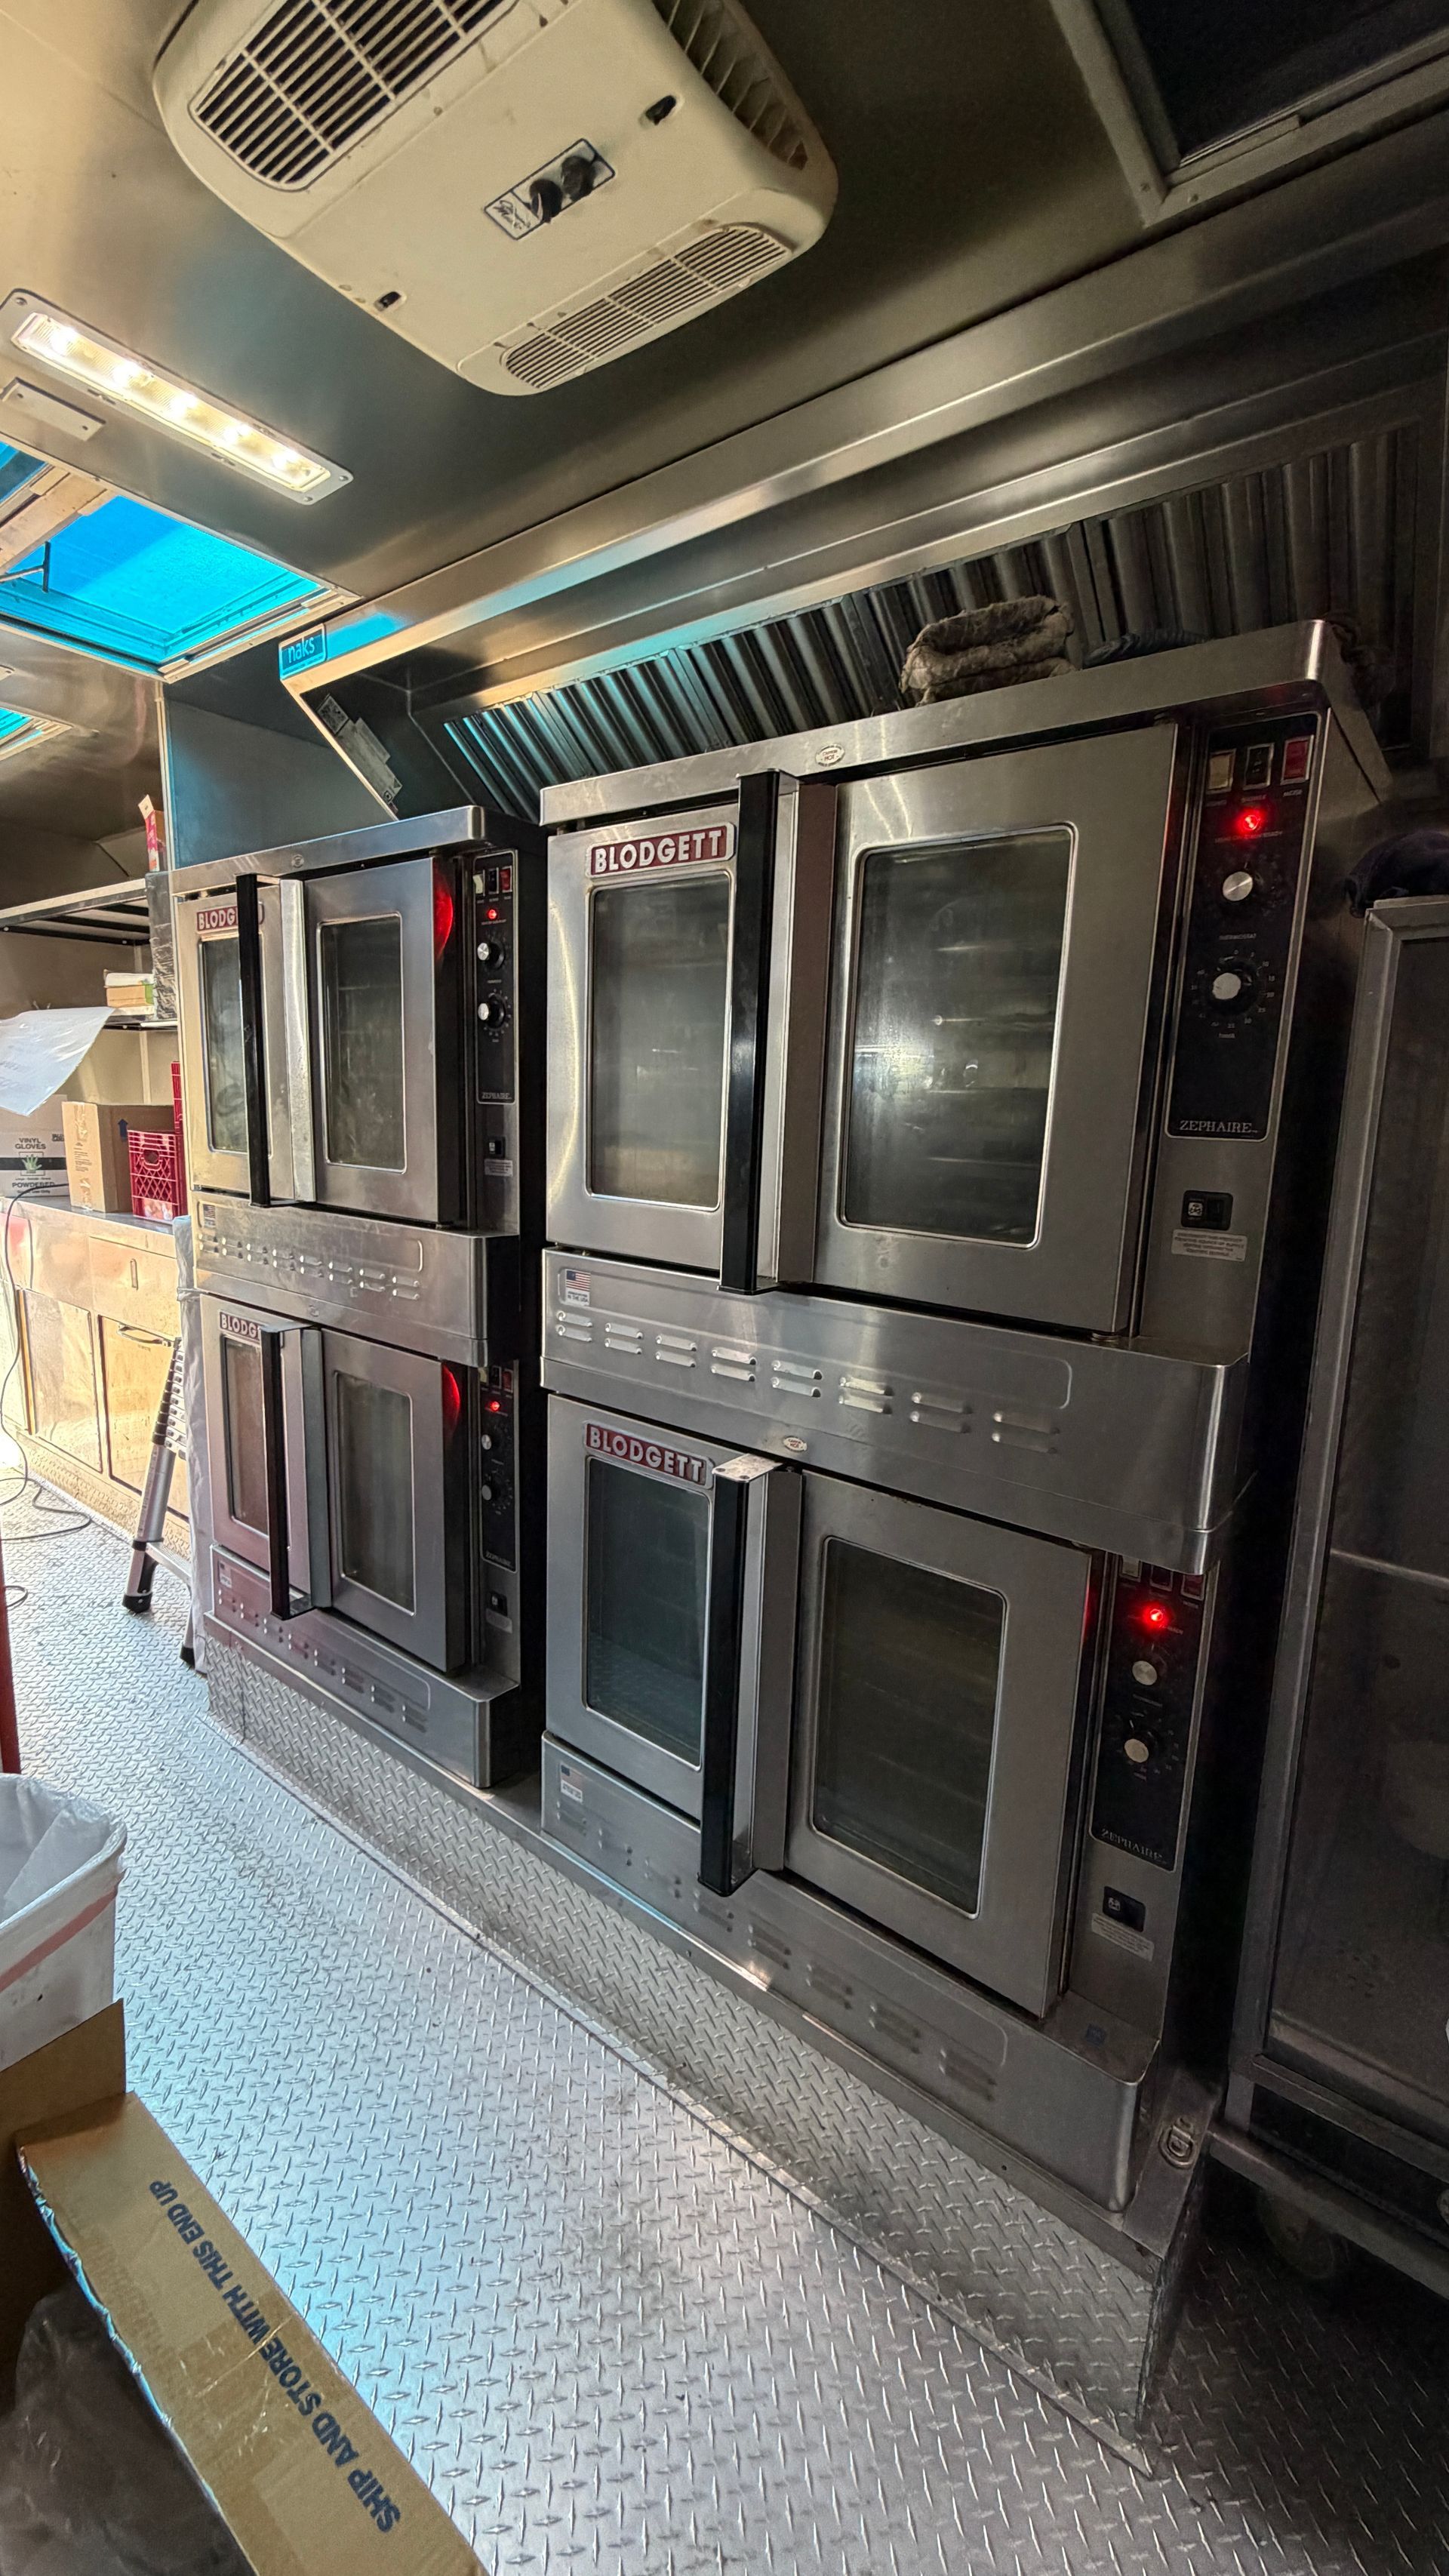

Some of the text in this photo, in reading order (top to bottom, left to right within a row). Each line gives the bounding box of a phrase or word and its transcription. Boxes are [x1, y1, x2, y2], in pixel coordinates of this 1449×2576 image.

[288, 636, 315, 663] naks
[595, 829, 722, 874] BLODGETT
[198, 906, 238, 930] BLODG
[1180, 1120, 1253, 1134] ZEPHAIRE
[589, 1426, 703, 1482] BLODGETT
[149, 2181, 401, 2532] SHIP AND STORE WITH THIS END UP
